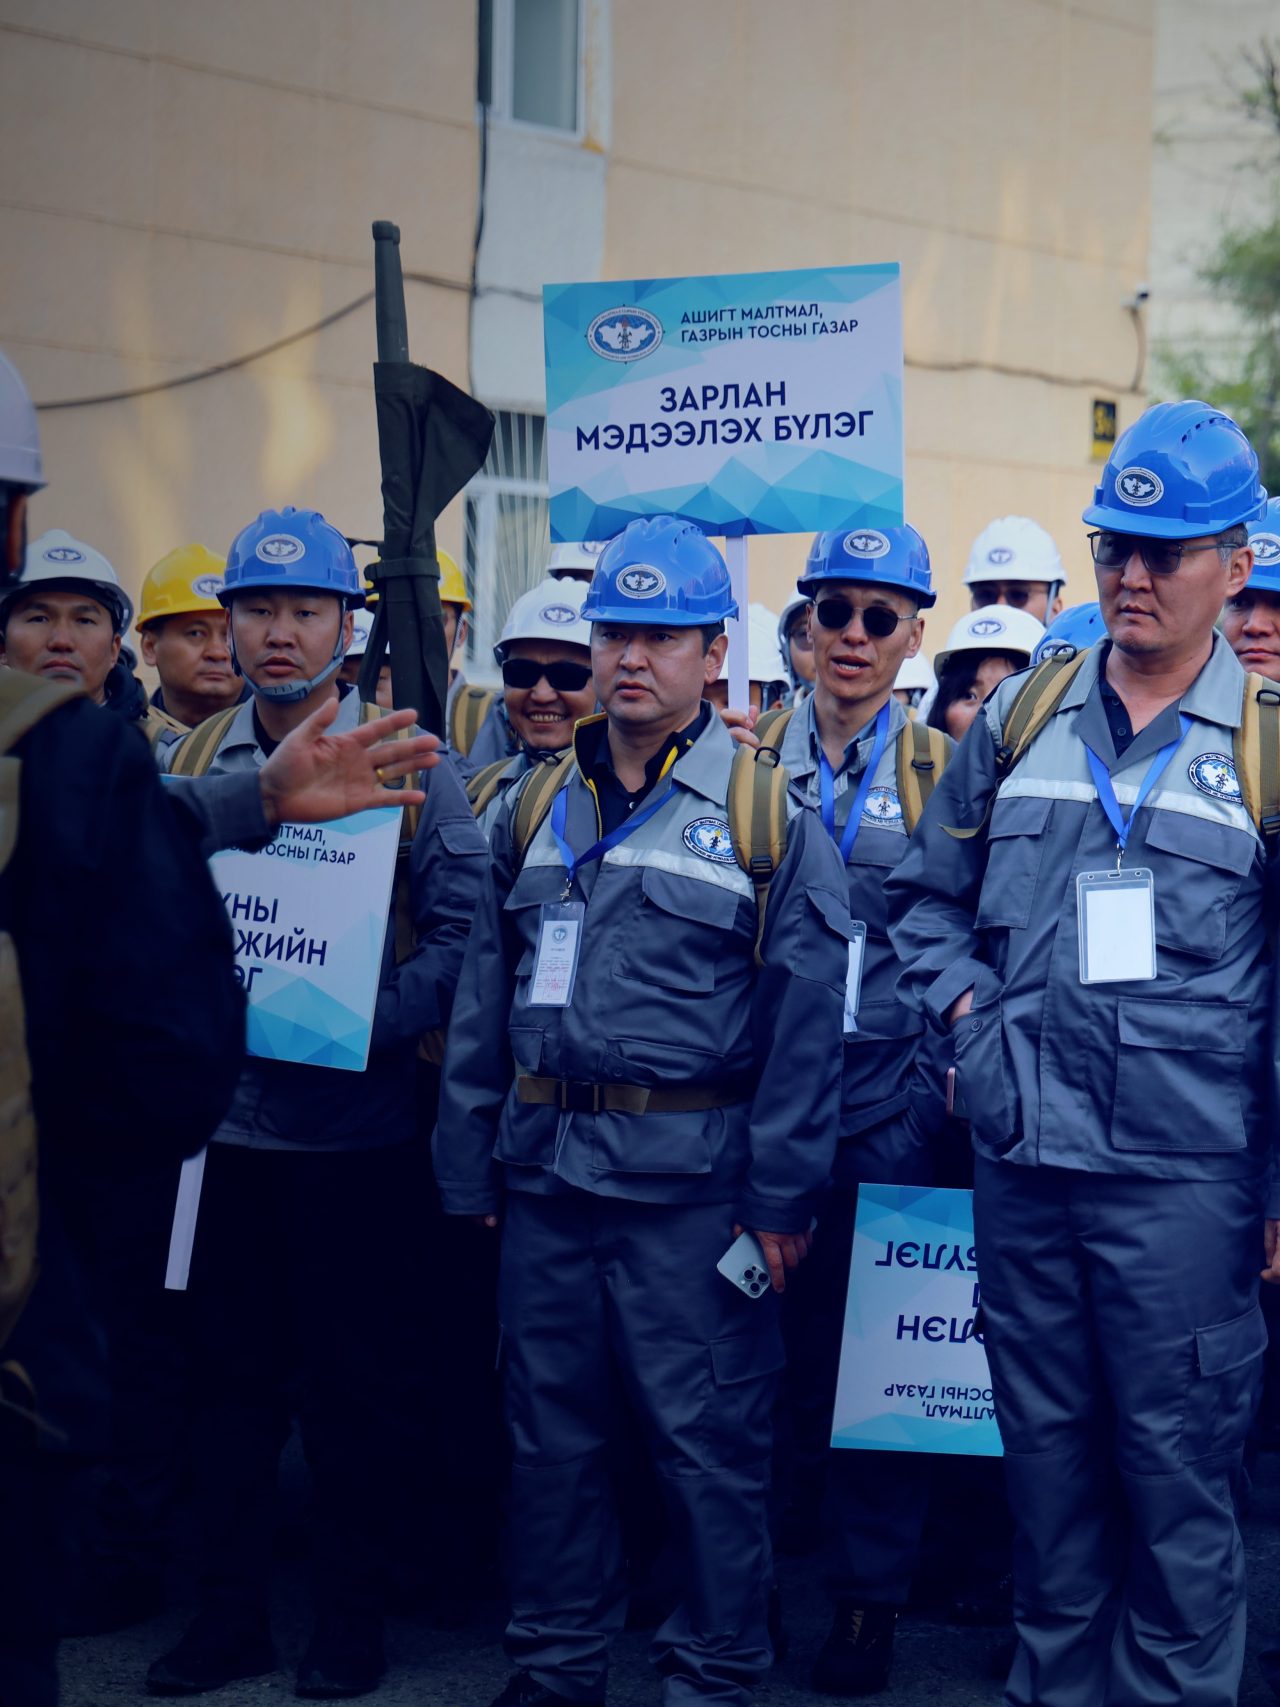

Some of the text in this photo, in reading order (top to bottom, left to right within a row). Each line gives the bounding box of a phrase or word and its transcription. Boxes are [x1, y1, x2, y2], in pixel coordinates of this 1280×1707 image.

[681, 303, 823, 324] АШИГТ МАЛТМАЛ,
[682, 320, 858, 343] ГАЗРЫН ТОСНЫ ГАЗАР
[660, 381, 786, 412] ЗАРЛАН
[576, 411, 873, 453] МЭДЭЭЛЭХ БҮЛЭГ
[260, 843, 355, 864] ОСНЫ ГАЗАР
[884, 1384, 994, 1401] ОСНЫ ГАЗАР
[922, 1401, 996, 1419] АЛТМАЛ,
